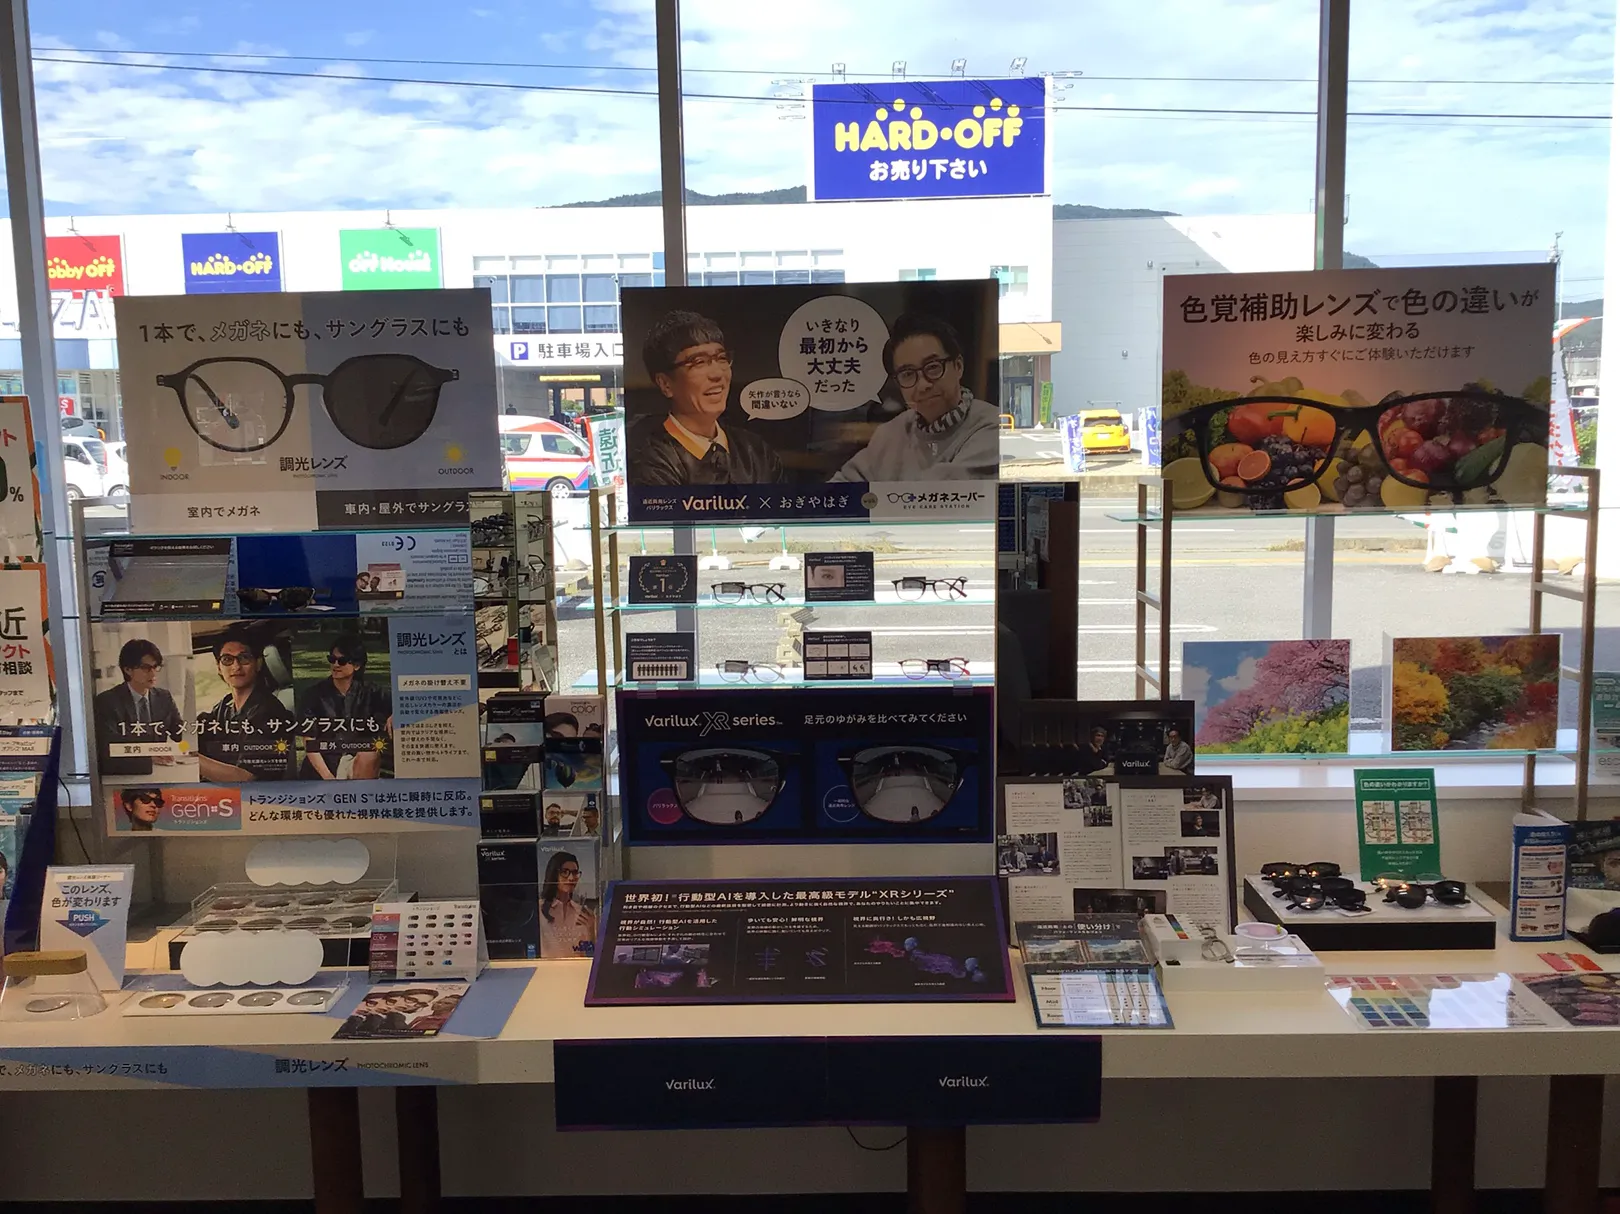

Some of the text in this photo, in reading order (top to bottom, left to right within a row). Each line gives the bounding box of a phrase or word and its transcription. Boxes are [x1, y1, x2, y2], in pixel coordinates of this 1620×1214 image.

[869, 159, 988, 181] お売り下さい
[47, 260, 116, 280] obby OFF
[1180, 285, 1539, 324] 色覚補助レンズで色の違いが
[139, 316, 470, 344] 1本で、メガネにも、サングラスにも
[806, 319, 860, 333] いきなり
[1296, 322, 1420, 343] 楽しみに変わる
[538, 342, 624, 359] 駐車場入口
[799, 336, 869, 356] 最初から
[1248, 345, 1475, 366] 色の見え方すぐにご体験いただけます
[806, 358, 862, 375] 大丈夫
[748, 389, 801, 399] 矢作が言うなら
[814, 380, 856, 394] だった
[751, 400, 798, 410] 間違いない
[279, 454, 348, 472] 調光レンズ
[438, 467, 475, 475] OUTDOOR
[779, 496, 849, 510] おぎやはぎ
[918, 492, 986, 502] メガネスーパー
[187, 506, 261, 518] 室内でメガネ
[396, 631, 467, 648] 調光レンズ
[0, 644, 30, 659] クト
[0, 661, 33, 675] 相談
[570, 704, 598, 714] color
[118, 716, 380, 736] 1本で、メガネにも、サングラスにも
[803, 713, 967, 725] 足元のゆがみを比べてみてください
[124, 745, 142, 754] 室内
[222, 743, 239, 752] 車内
[319, 741, 337, 750] 屋外
[249, 793, 326, 805] トランジションズ
[333, 793, 359, 804] GEN
[249, 806, 473, 821] どんな環境でも優れた視界体験を提供します。
[61, 883, 112, 894] このレンズ、
[51, 896, 122, 908] 色が変わります
[73, 914, 95, 922] PUSH
[275, 1057, 348, 1073] 調光レンズ
[356, 1061, 412, 1069] PHOTOCHROMIC
